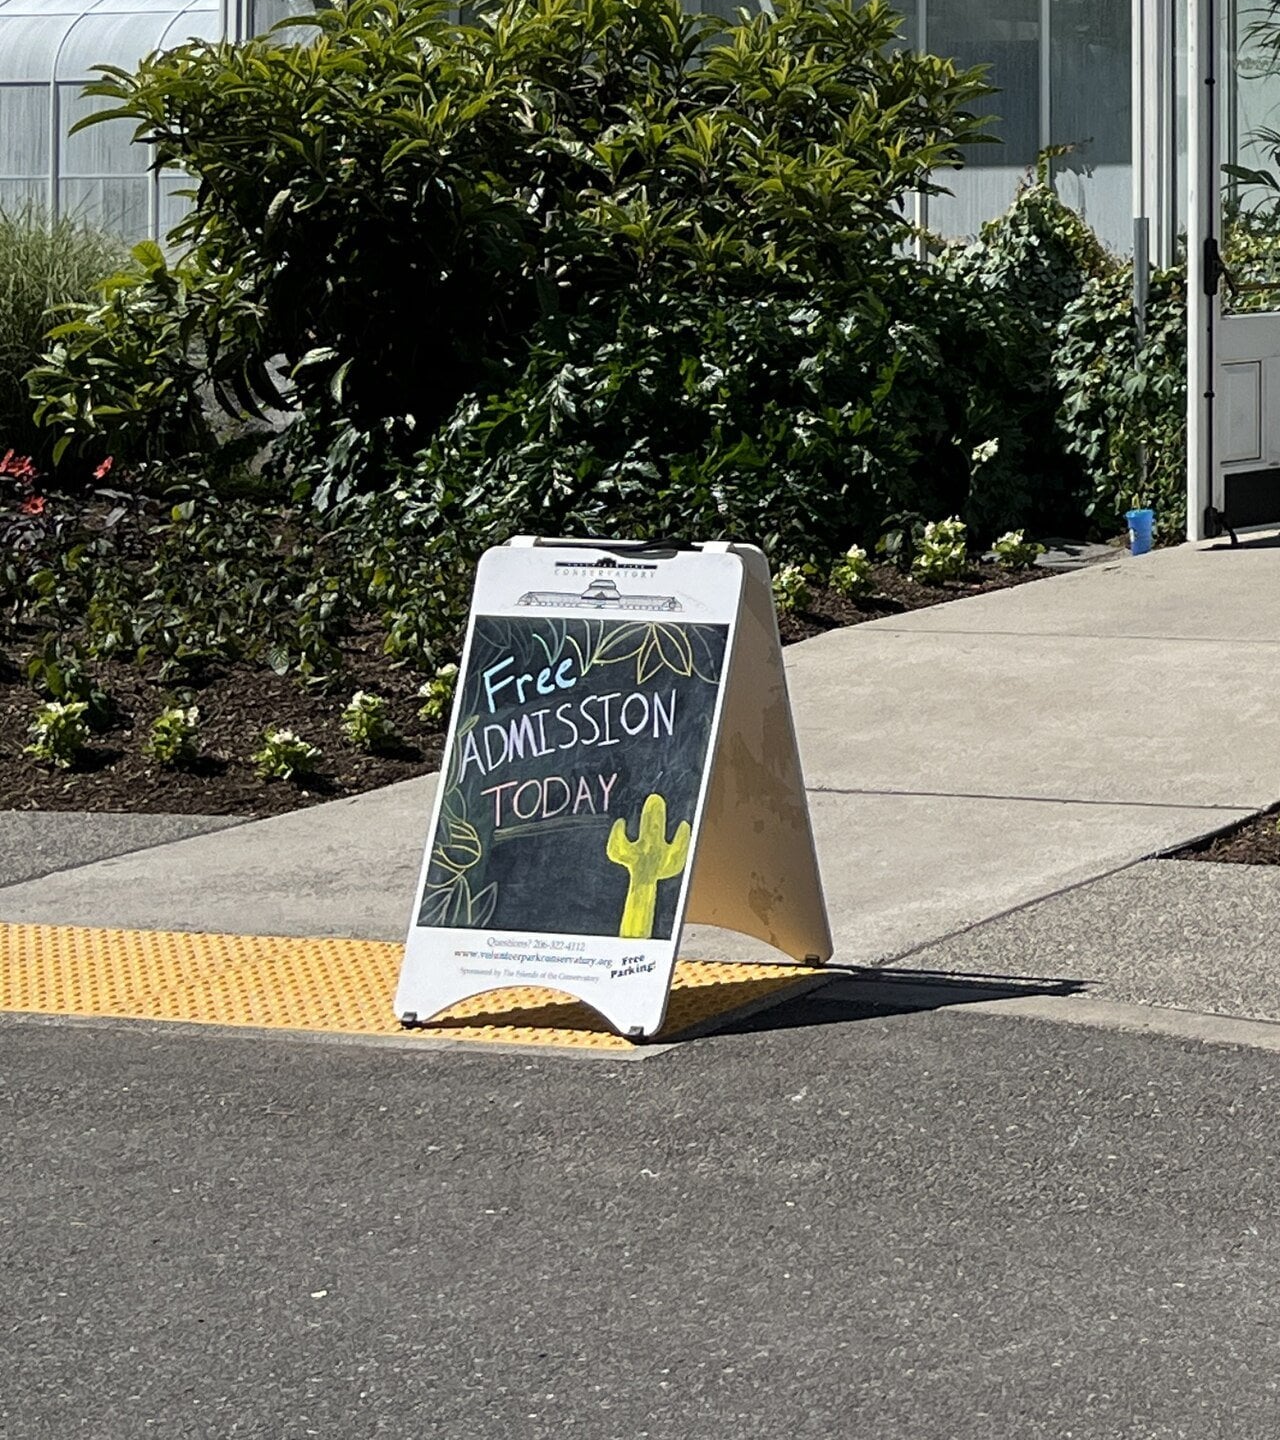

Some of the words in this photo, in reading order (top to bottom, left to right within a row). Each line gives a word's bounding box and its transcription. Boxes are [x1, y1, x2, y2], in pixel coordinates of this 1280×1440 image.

[482, 656, 577, 713] Free
[458, 688, 677, 785] ADMISSION
[480, 772, 618, 827] TODAY
[487, 936, 532, 949] Questions?
[621, 953, 646, 966] Free
